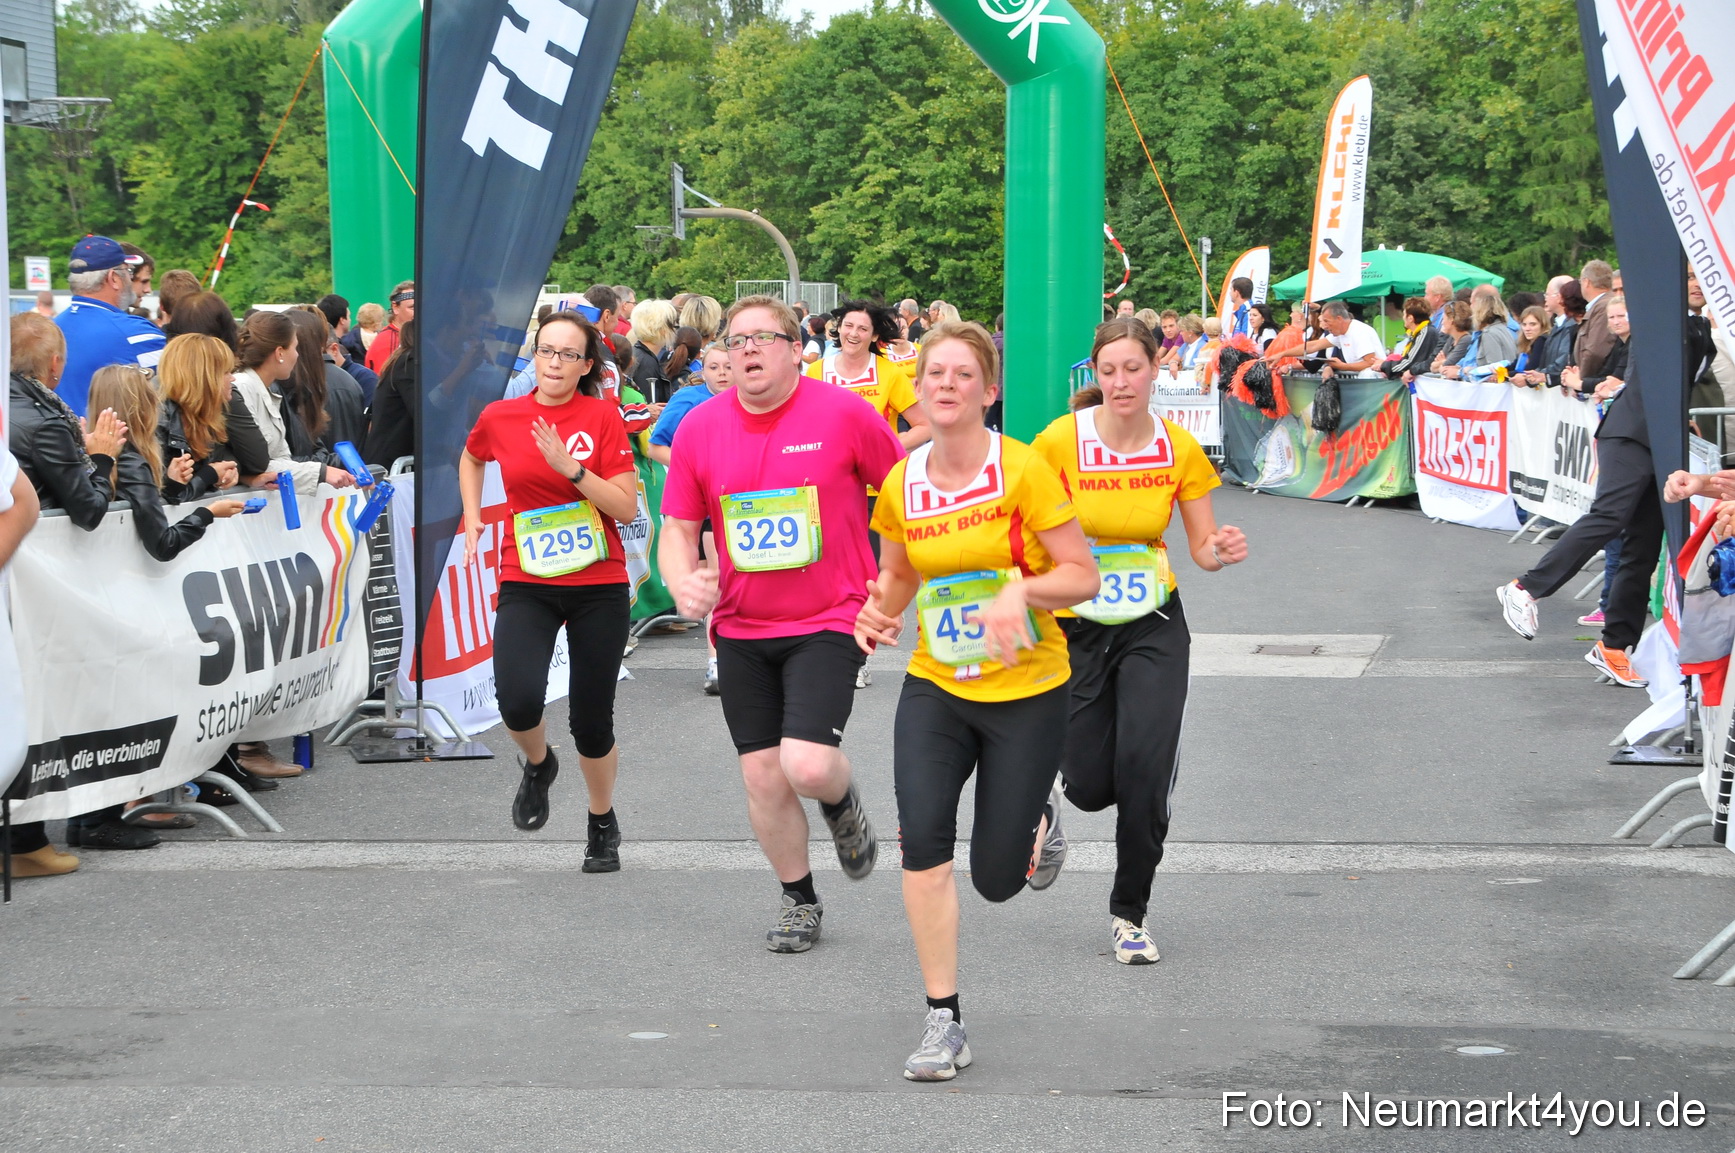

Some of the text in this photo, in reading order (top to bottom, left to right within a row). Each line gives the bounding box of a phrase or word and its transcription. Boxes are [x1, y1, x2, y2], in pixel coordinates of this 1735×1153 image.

[1351, 115, 1369, 202] www.klebl.de
[856, 389, 880, 398] ÖGL
[1167, 409, 1211, 433] PRINT
[789, 442, 823, 452] DAHMIT
[1422, 409, 1500, 487] MEIER
[1078, 473, 1175, 491] MAX BÖGL
[736, 516, 799, 551] 329
[906, 505, 1008, 542] MAX BÖGL
[522, 526, 593, 560] 1295
[748, 551, 767, 560] Josef
[541, 558, 570, 568] Stefanie
[1091, 572, 1147, 604] 35
[182, 551, 324, 687] swn
[936, 604, 986, 643] 45
[71, 749, 94, 771] die
[96, 738, 161, 766] verbinden
